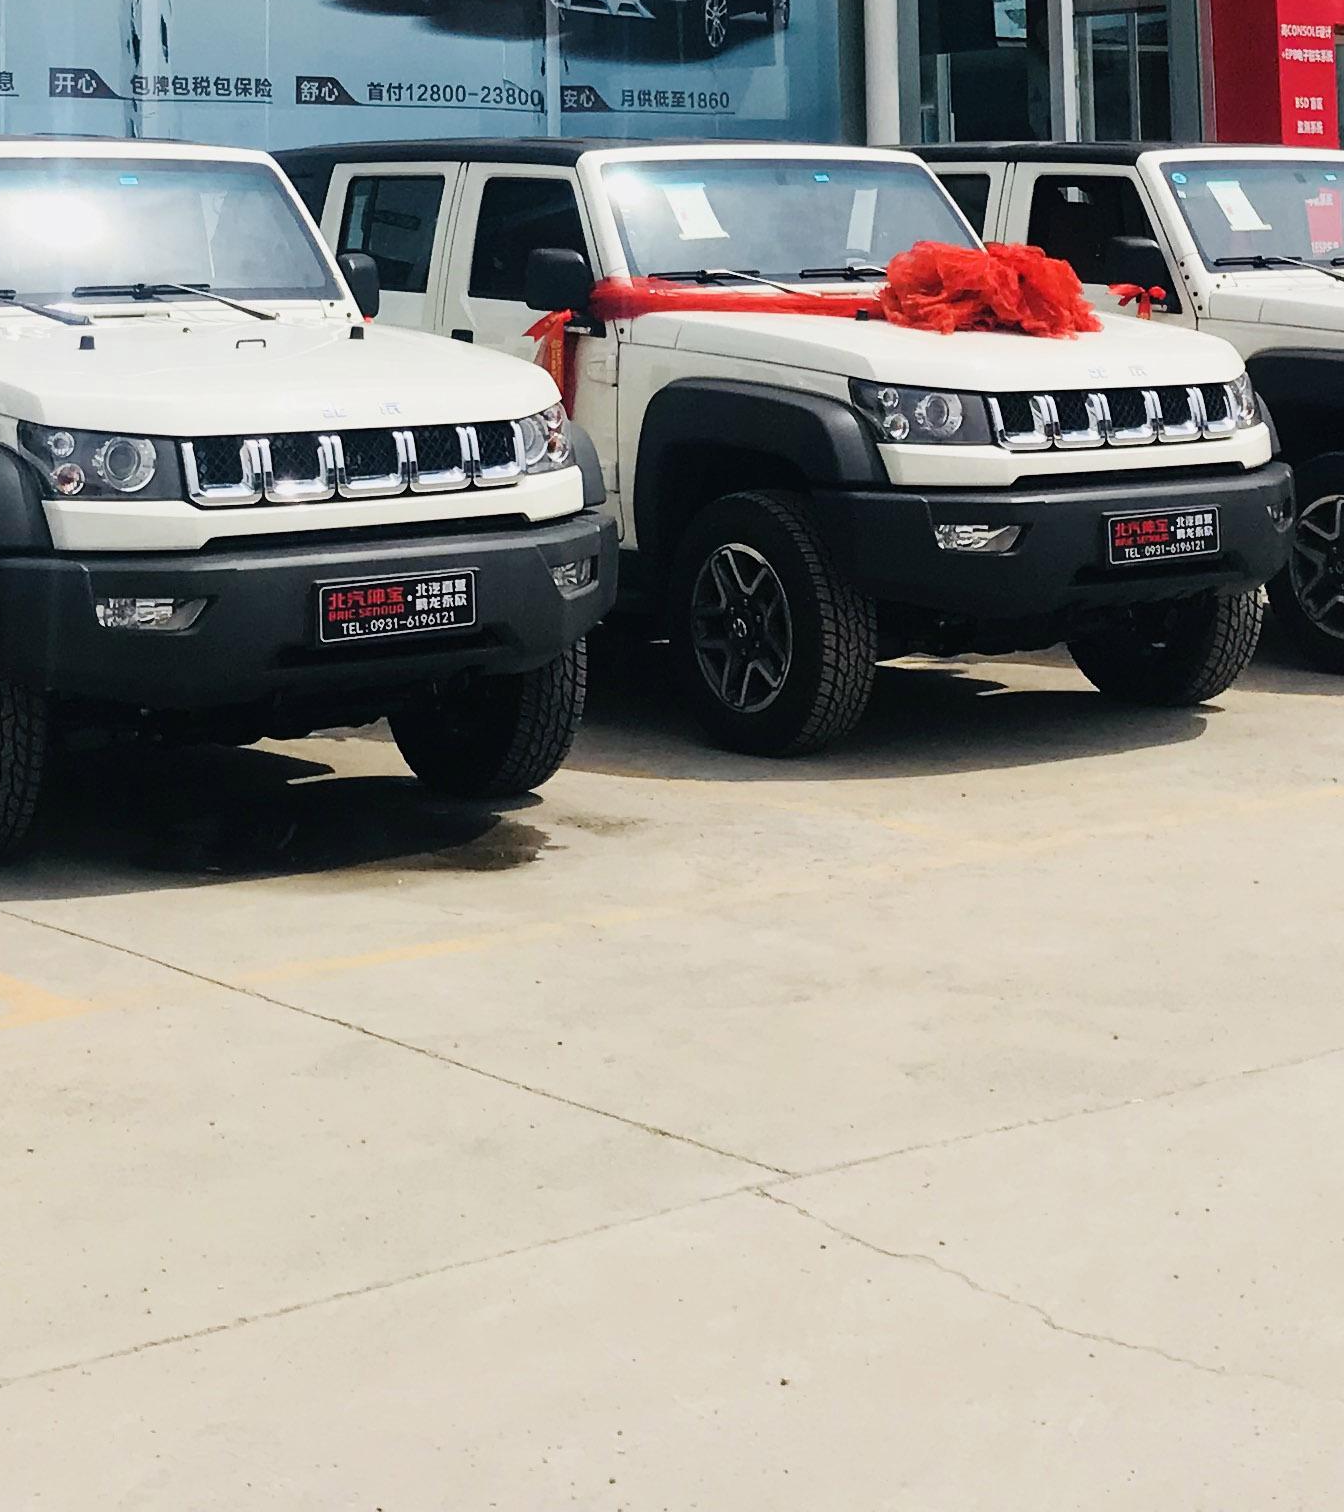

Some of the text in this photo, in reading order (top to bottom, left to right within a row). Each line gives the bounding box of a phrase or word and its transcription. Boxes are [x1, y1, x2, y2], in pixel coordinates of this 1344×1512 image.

[54, 70, 273, 99] 开心 包牌包税包保险
[300, 80, 542, 108] 舒心 首付12800-23800
[562, 88, 730, 111] 安心 月供低至1860
